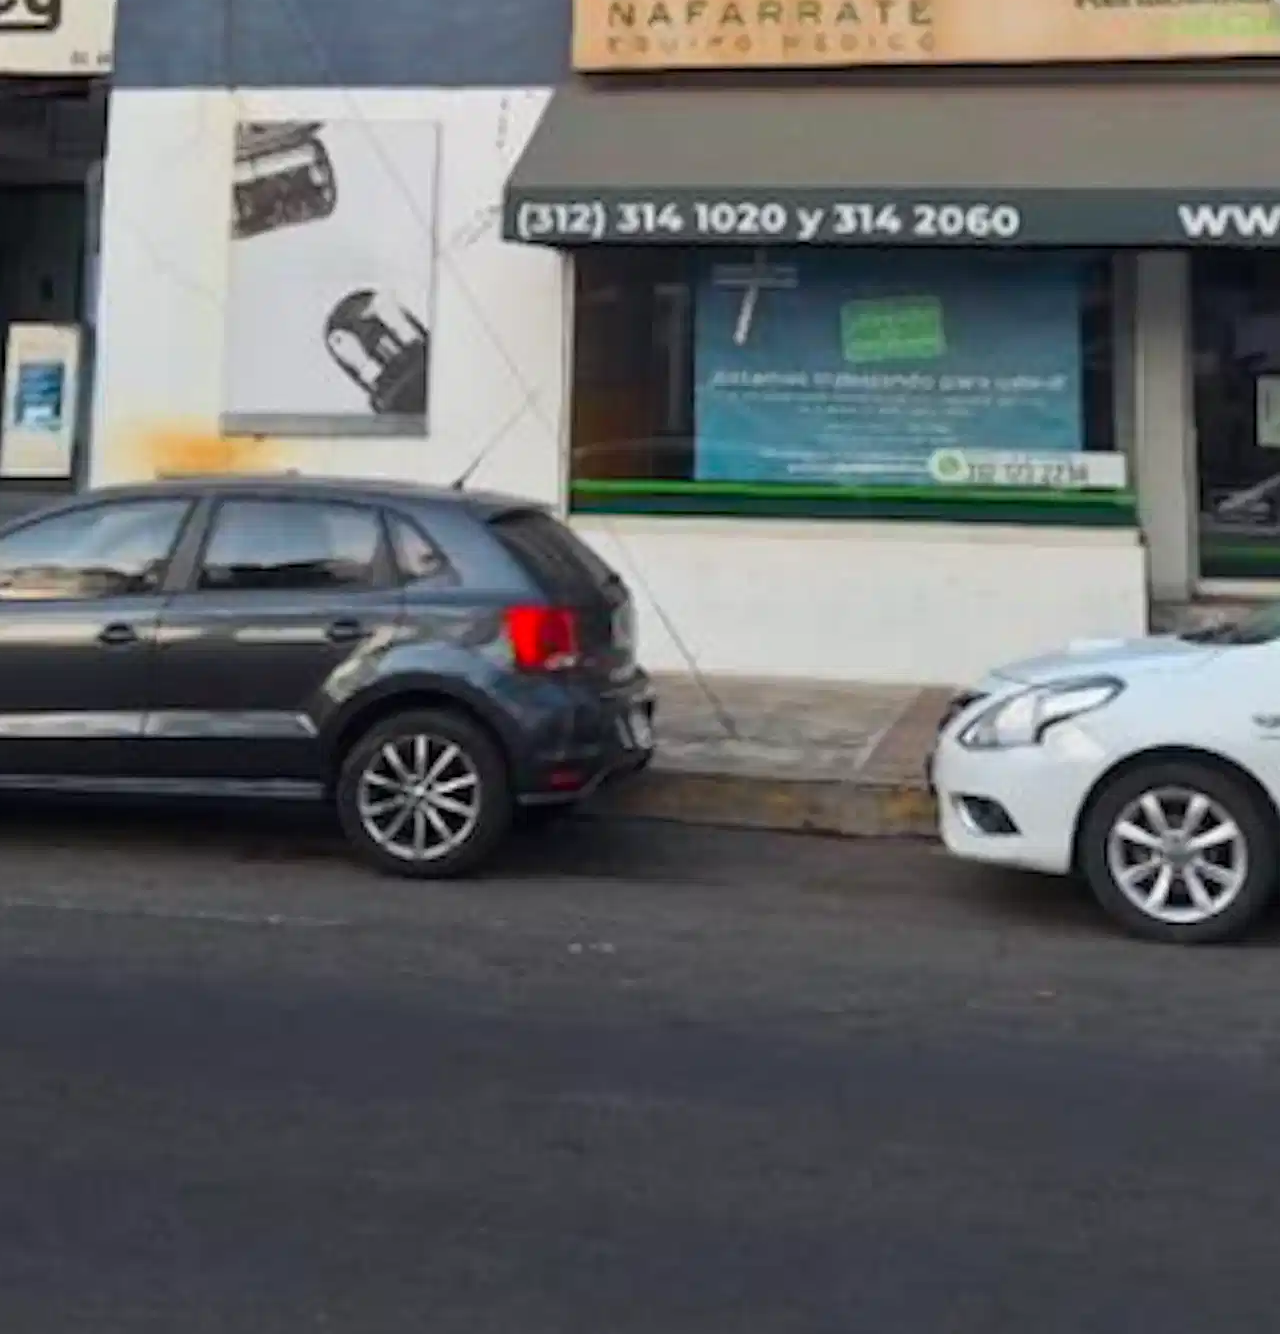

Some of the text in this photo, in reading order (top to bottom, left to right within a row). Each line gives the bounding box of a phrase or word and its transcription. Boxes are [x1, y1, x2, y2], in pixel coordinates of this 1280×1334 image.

[517, 202, 1020, 240] (312) 314 1020 y 314 2060
